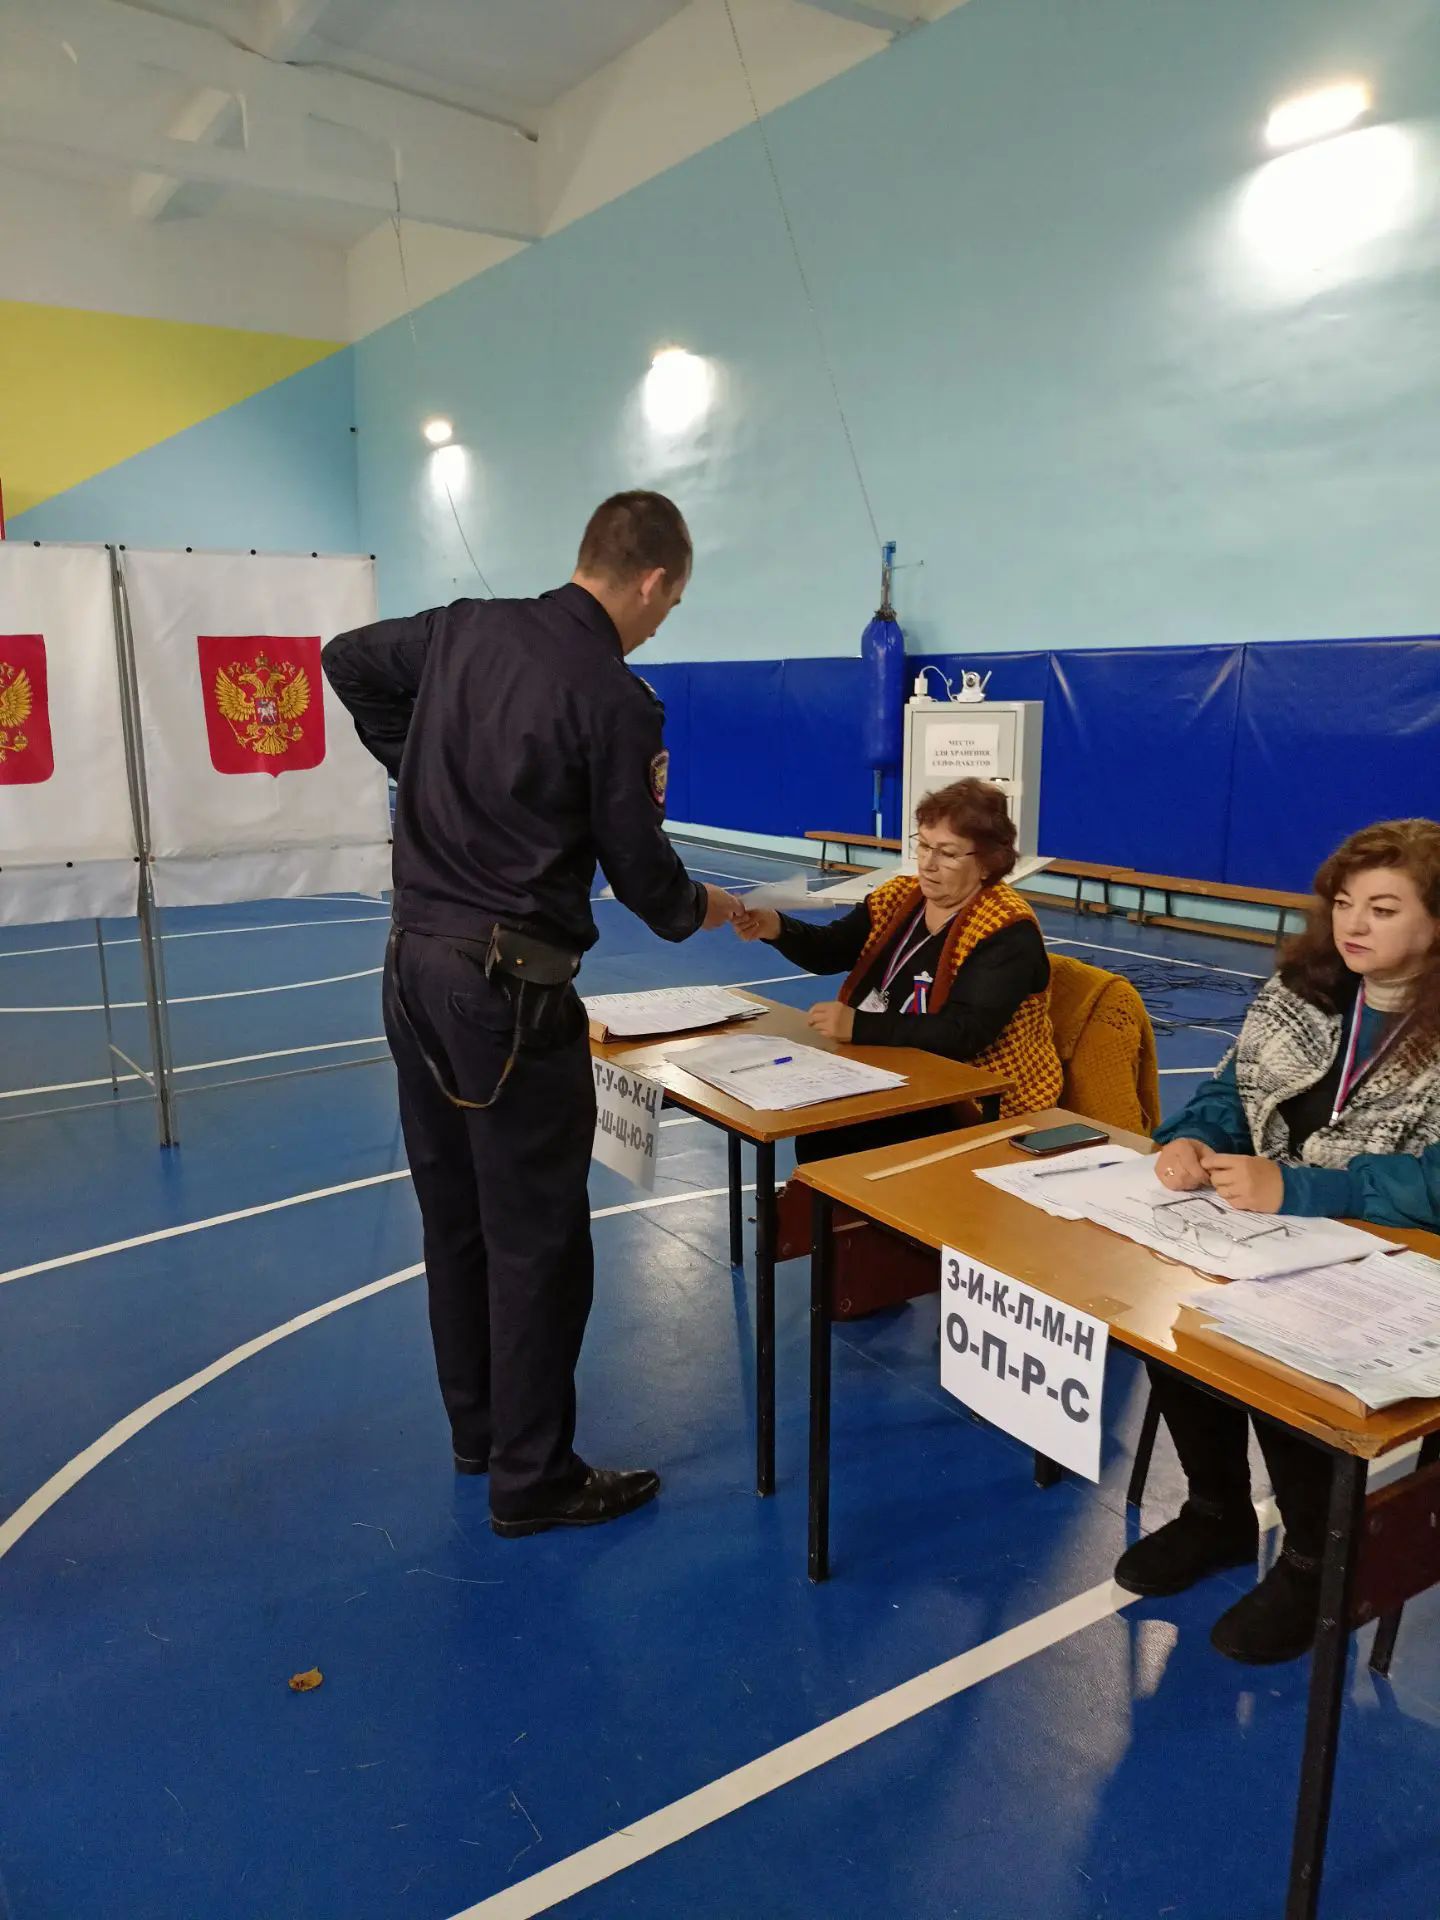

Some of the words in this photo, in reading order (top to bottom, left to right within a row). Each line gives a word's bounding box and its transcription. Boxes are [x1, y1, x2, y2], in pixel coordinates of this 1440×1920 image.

[594, 1062, 657, 1119] Т-У-Ф-Х-Ц
[595, 1105, 654, 1157] -Ш-Щ-Ю-Я
[946, 1258, 1095, 1362] З-И-К-Л-М-Н
[946, 1312, 1090, 1423] О-П-Р-С
